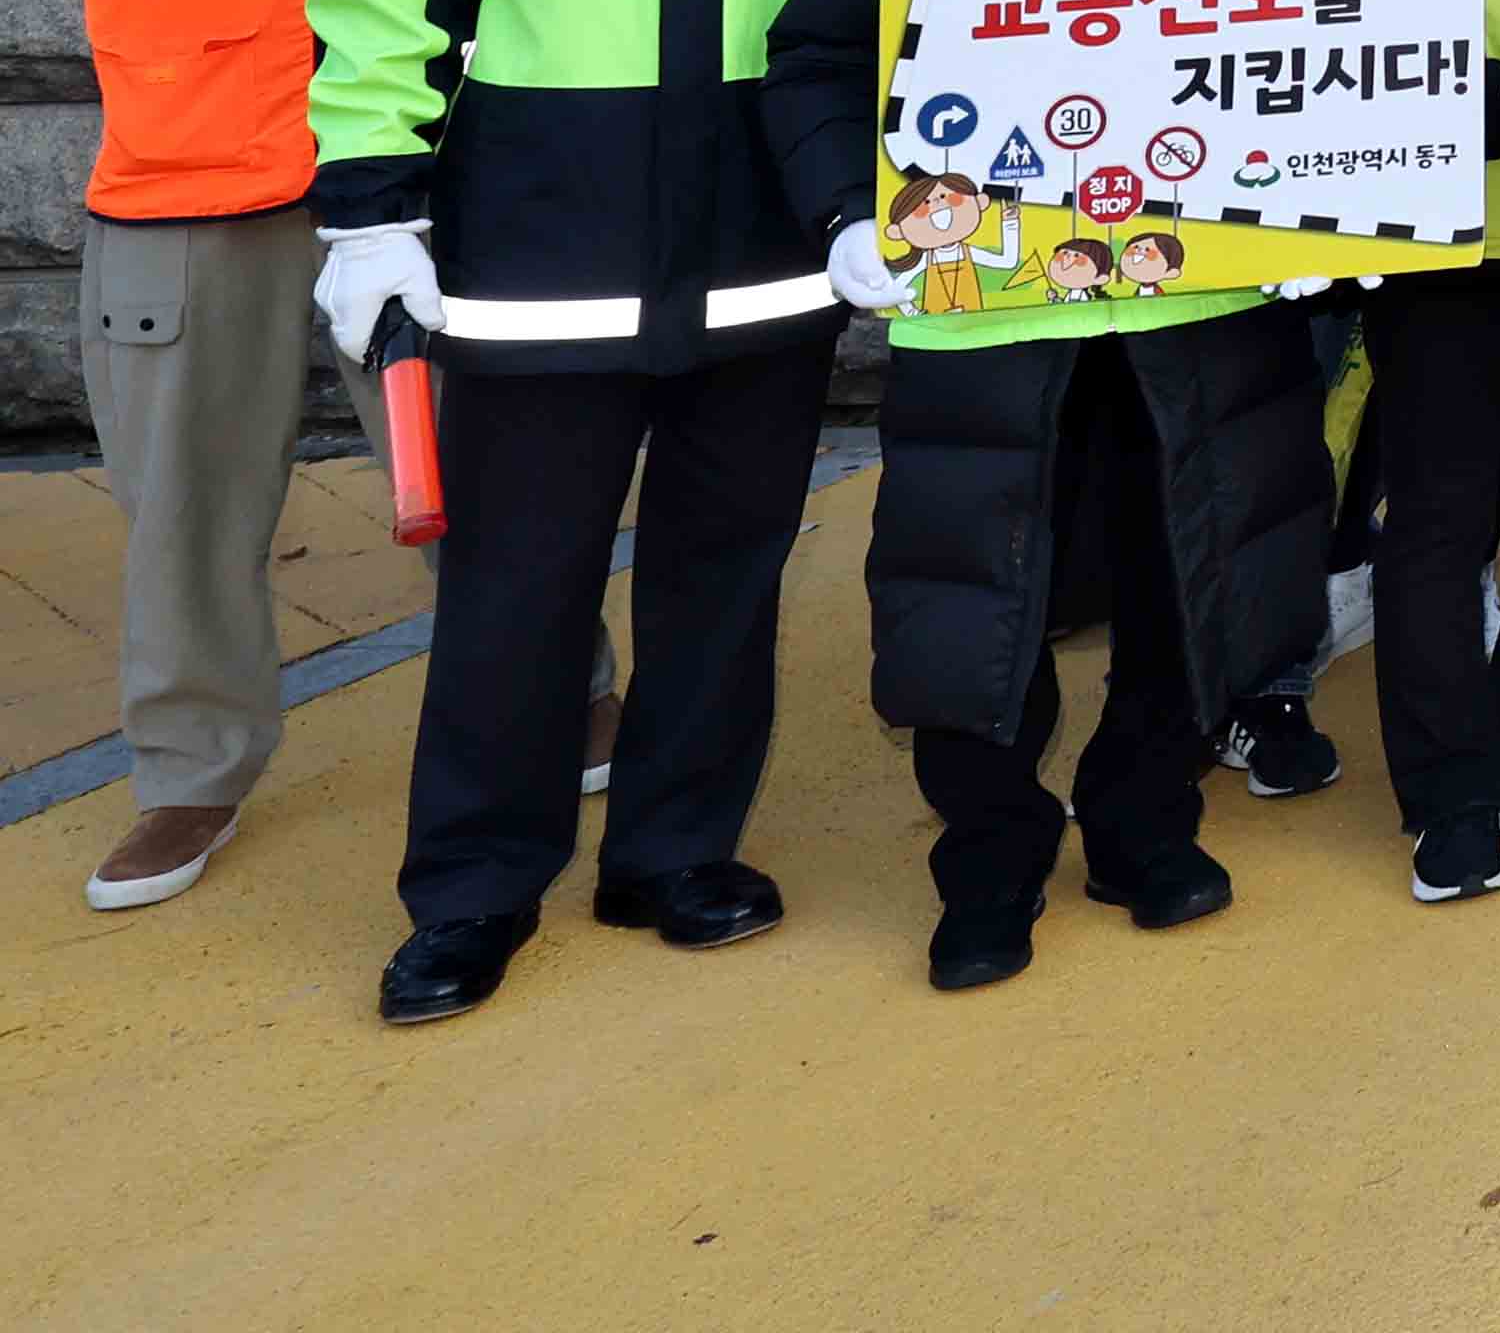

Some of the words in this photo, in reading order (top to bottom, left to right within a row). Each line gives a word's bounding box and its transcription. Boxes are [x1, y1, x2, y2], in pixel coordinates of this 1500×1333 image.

[1171, 39, 1470, 116] 지킵시다!
[1059, 108, 1092, 132] 30
[1287, 149, 1409, 177] 인천광역시
[1415, 144, 1458, 168] 동구
[1088, 174, 1133, 196] 정지
[1091, 194, 1132, 215] STOP
